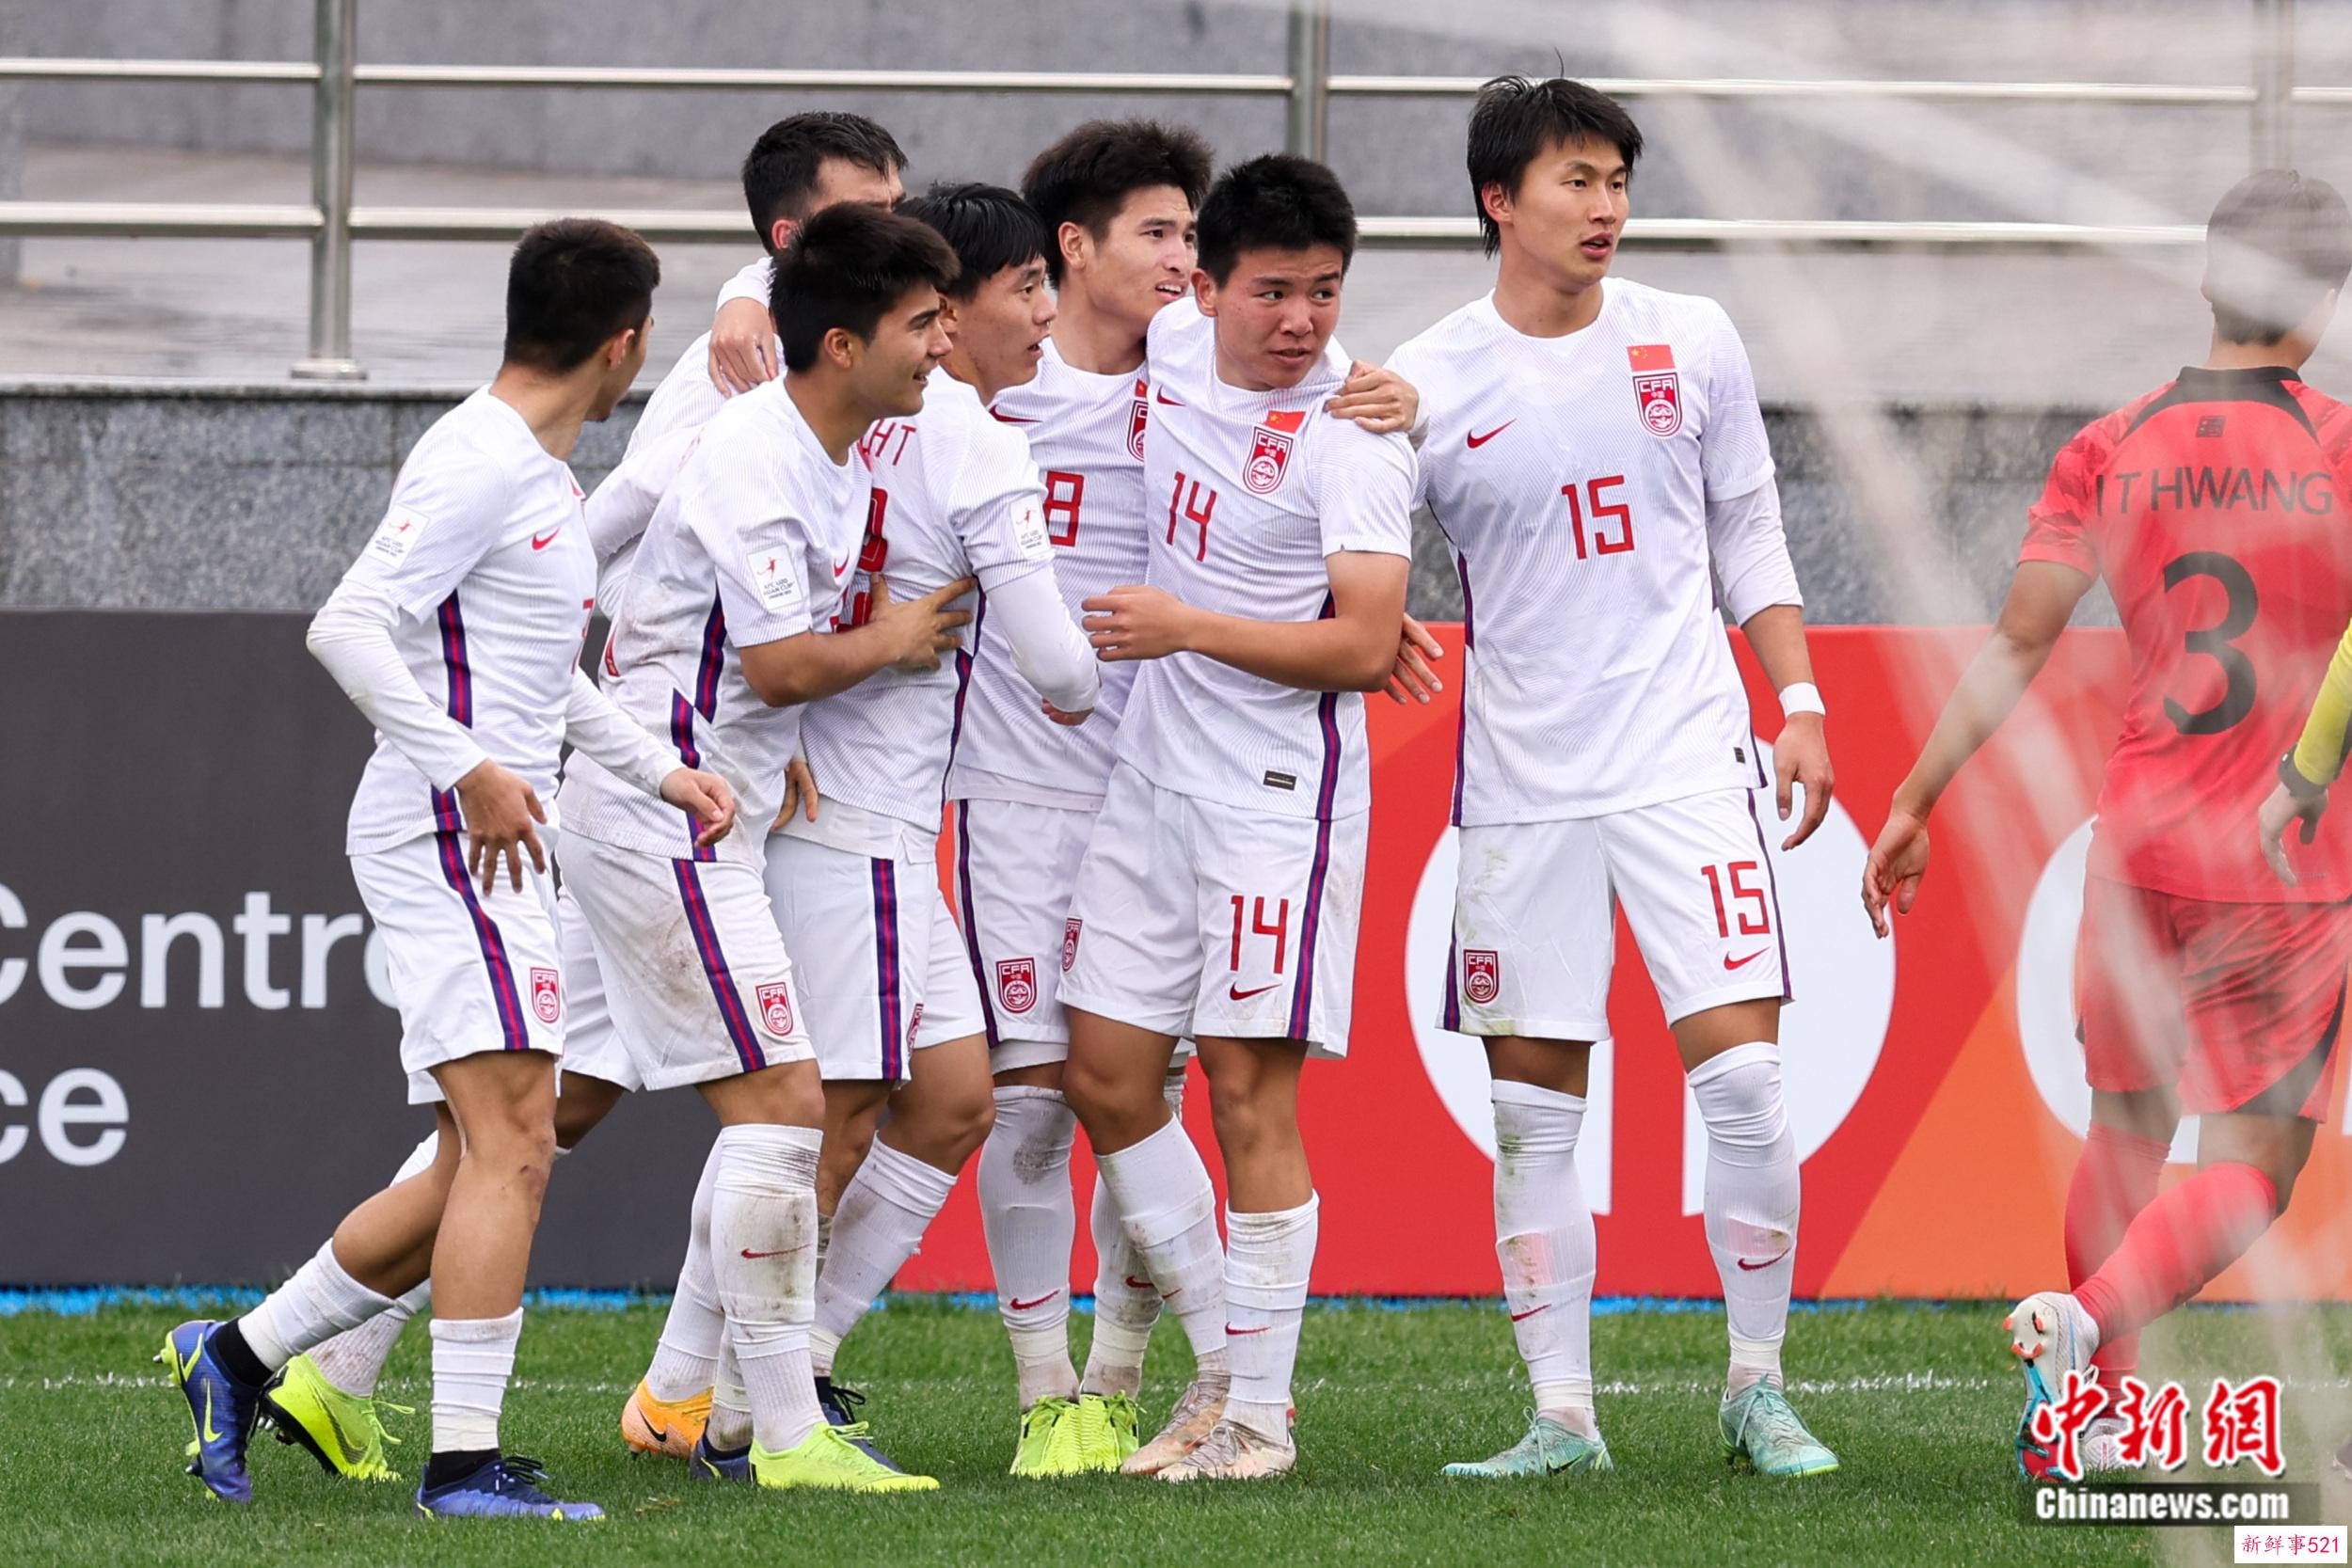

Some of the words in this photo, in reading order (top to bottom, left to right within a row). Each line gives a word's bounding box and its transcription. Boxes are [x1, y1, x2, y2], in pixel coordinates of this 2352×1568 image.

[1639, 379, 1674, 392] CFA
[1257, 435, 1288, 453] CFA
[1042, 470, 1085, 547] 8
[1167, 470, 1217, 562] 14
[1561, 474, 1635, 560] 15
[2150, 467, 2333, 515] HWANG
[2163, 551, 2259, 735] 3
[1230, 895, 1290, 974] 14
[1701, 861, 1771, 939] 15
[1002, 964, 1030, 974] CFA
[1469, 956, 1493, 965] CFA
